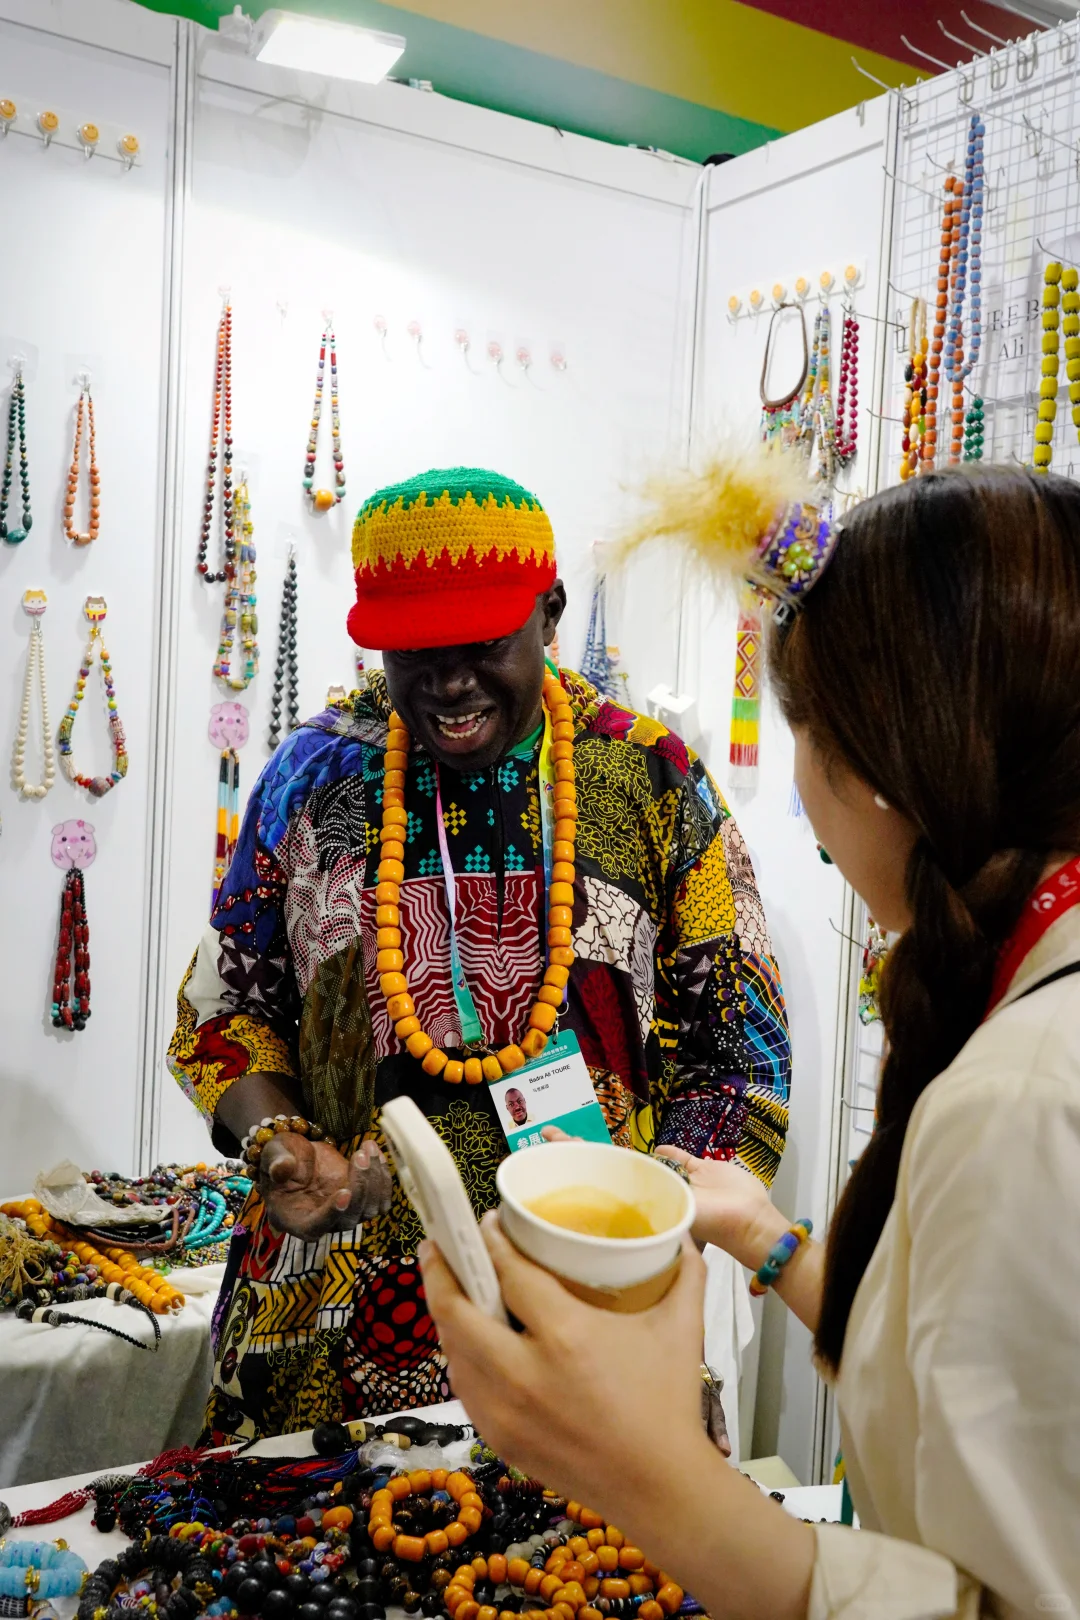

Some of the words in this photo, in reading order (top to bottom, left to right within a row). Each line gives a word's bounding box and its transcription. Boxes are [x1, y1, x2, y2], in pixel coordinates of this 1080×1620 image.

[999, 337, 1024, 359] Ali
[551, 1064, 571, 1075] TOURE
[517, 1132, 545, 1149] 参展
